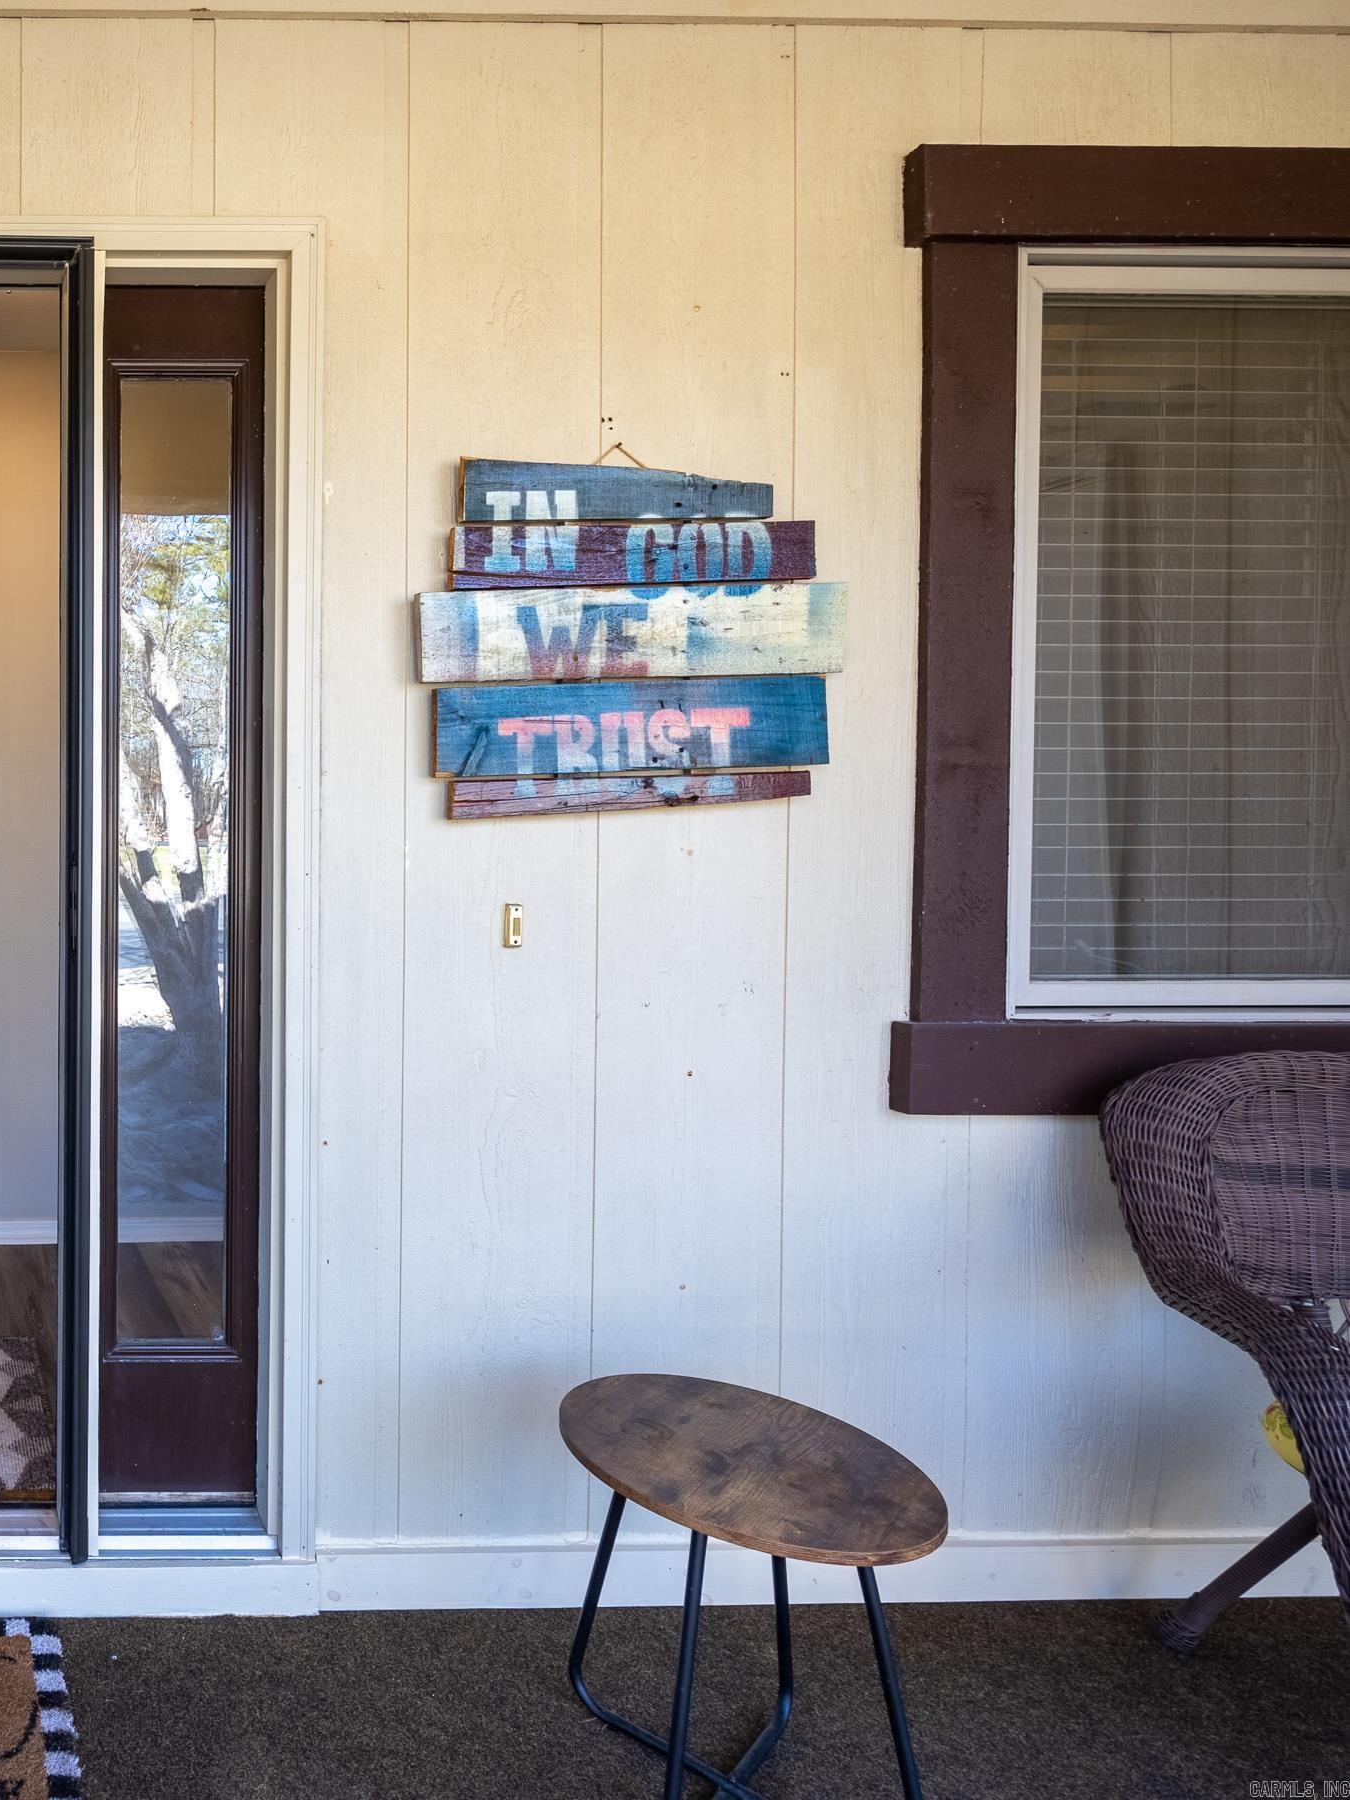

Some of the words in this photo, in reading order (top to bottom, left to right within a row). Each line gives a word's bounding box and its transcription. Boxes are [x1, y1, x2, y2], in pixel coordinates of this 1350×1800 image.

[484, 489, 579, 573] IN
[625, 513, 773, 600] GOD
[516, 602, 651, 679] WE
[497, 707, 751, 798] TRUST
